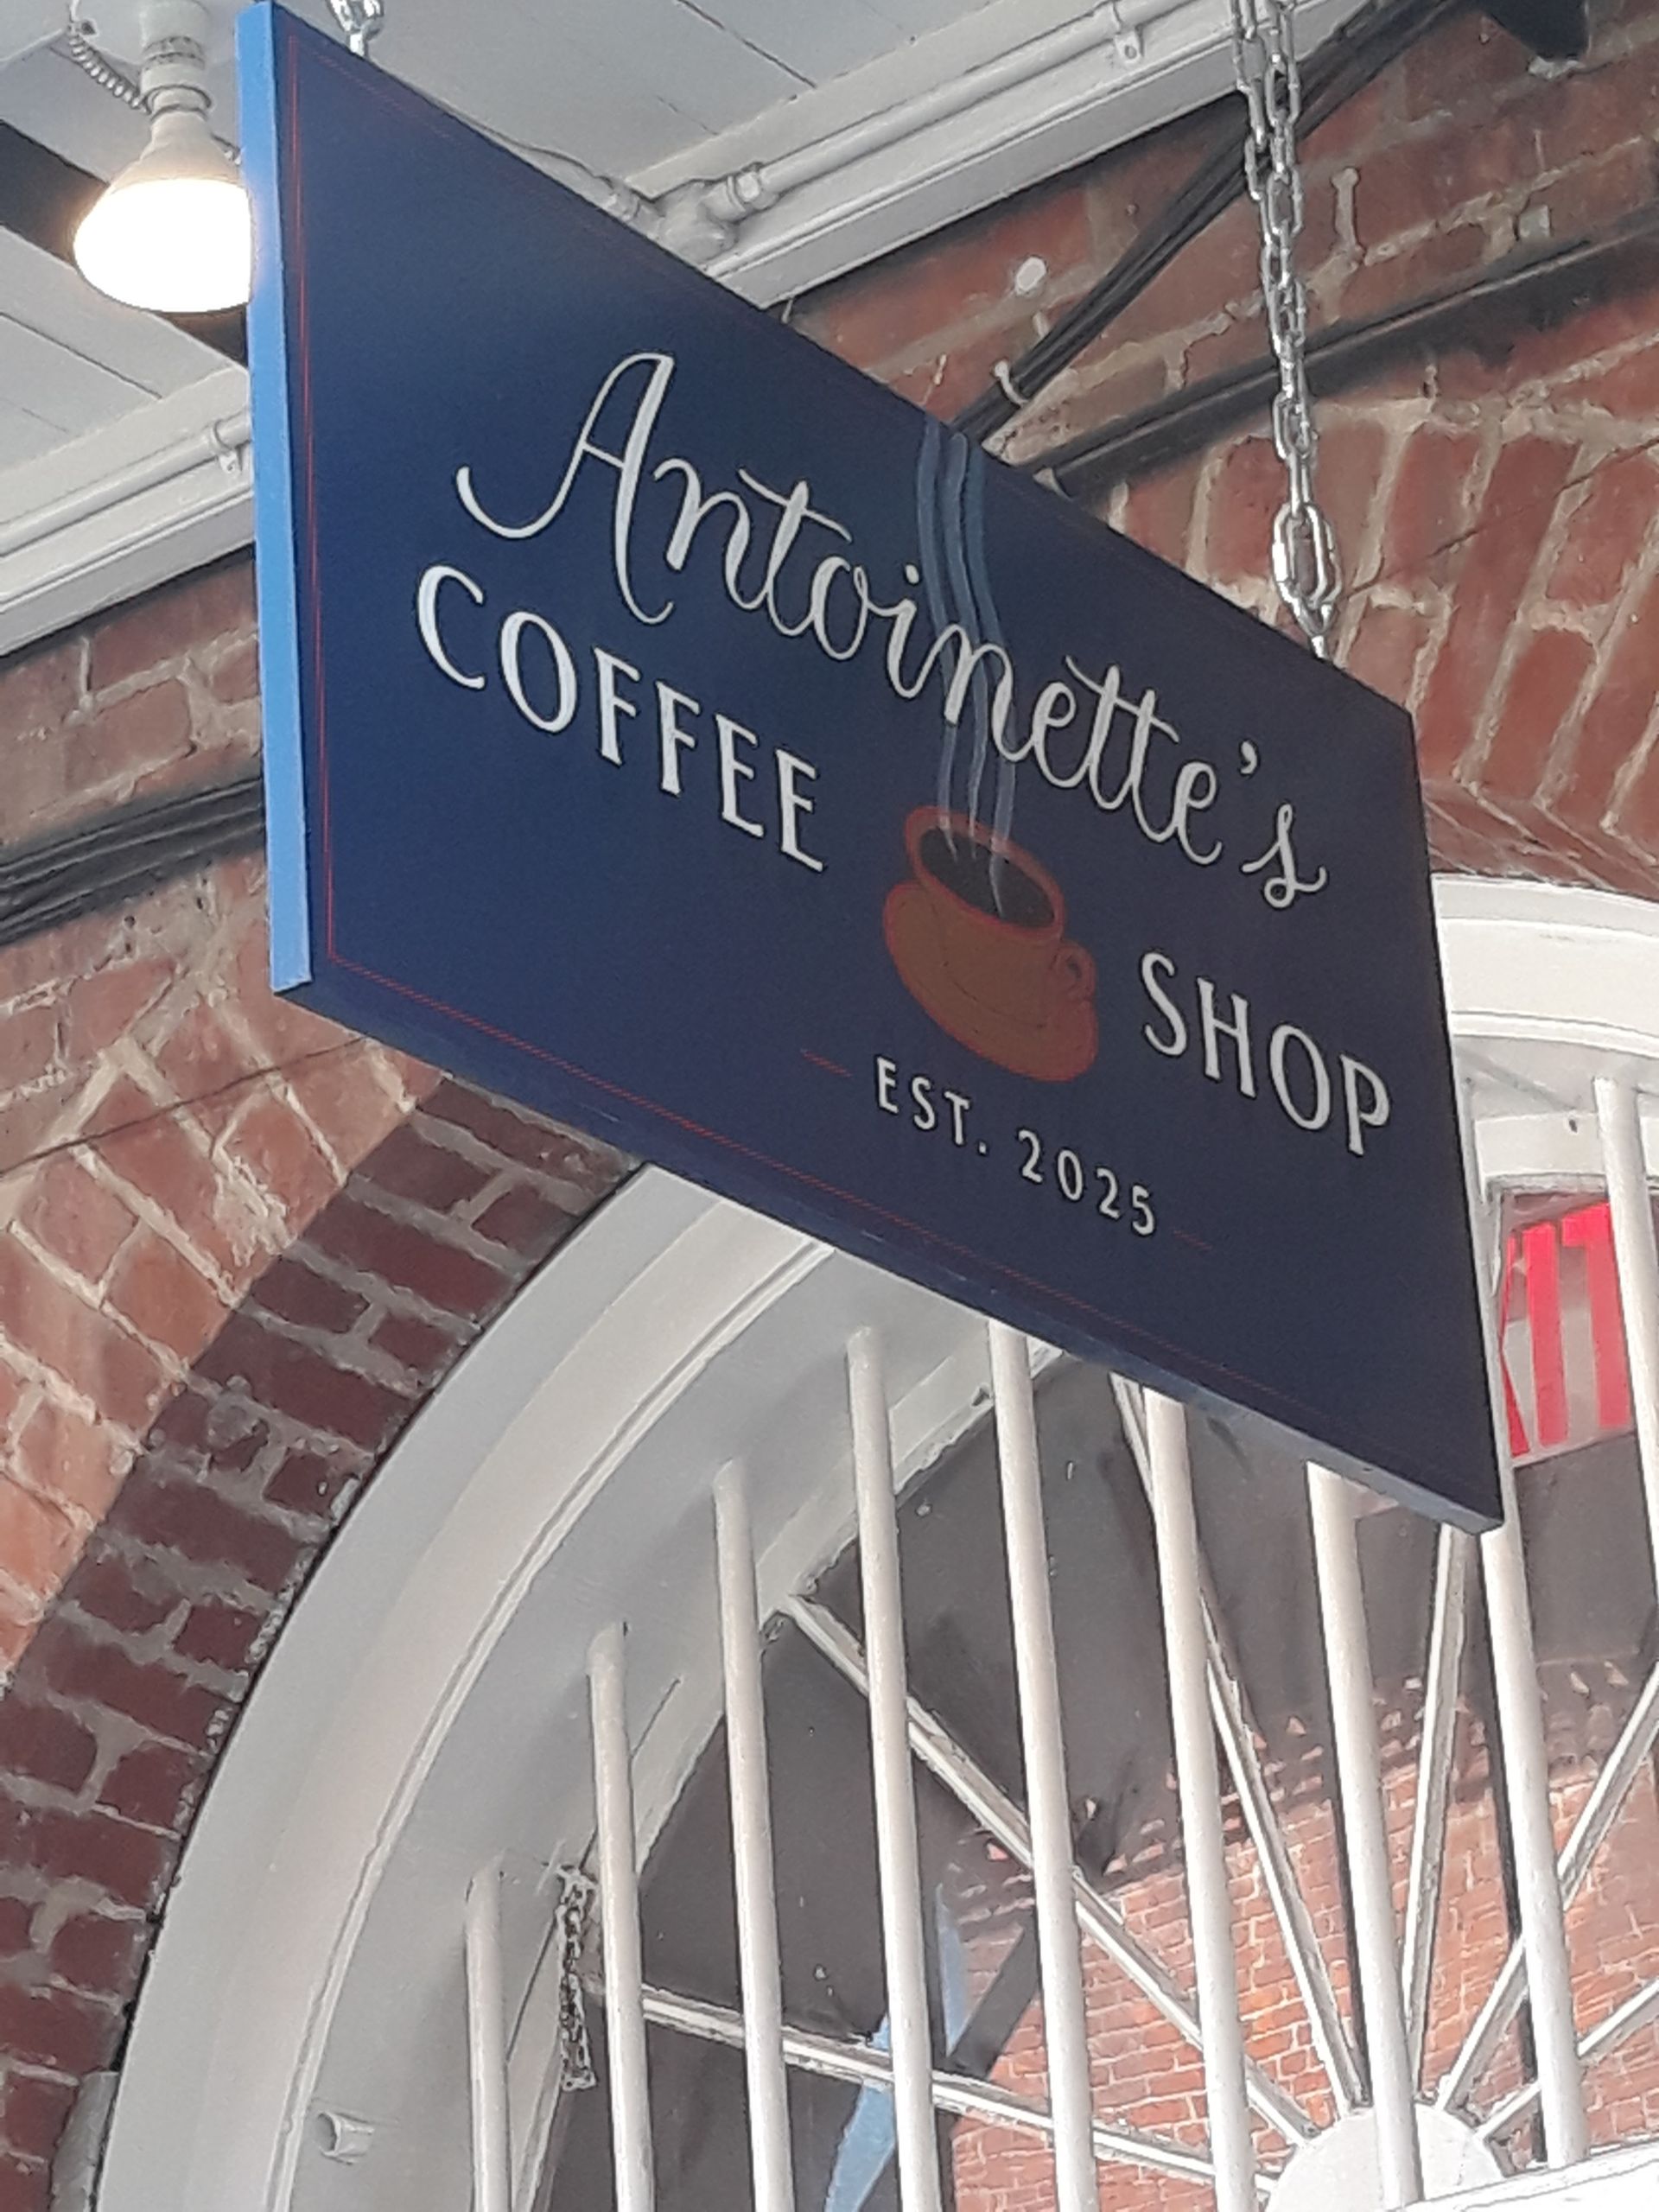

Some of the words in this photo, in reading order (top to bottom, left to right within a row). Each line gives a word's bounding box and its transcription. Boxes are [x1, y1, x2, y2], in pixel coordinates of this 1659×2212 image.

[416, 563, 823, 873] COFFEE
[1141, 951, 1390, 1156] SHOP
[455, 352, 1327, 909] Antoinette's
[875, 1056, 988, 1154] EST.
[1018, 1128, 1155, 1236] 2025
